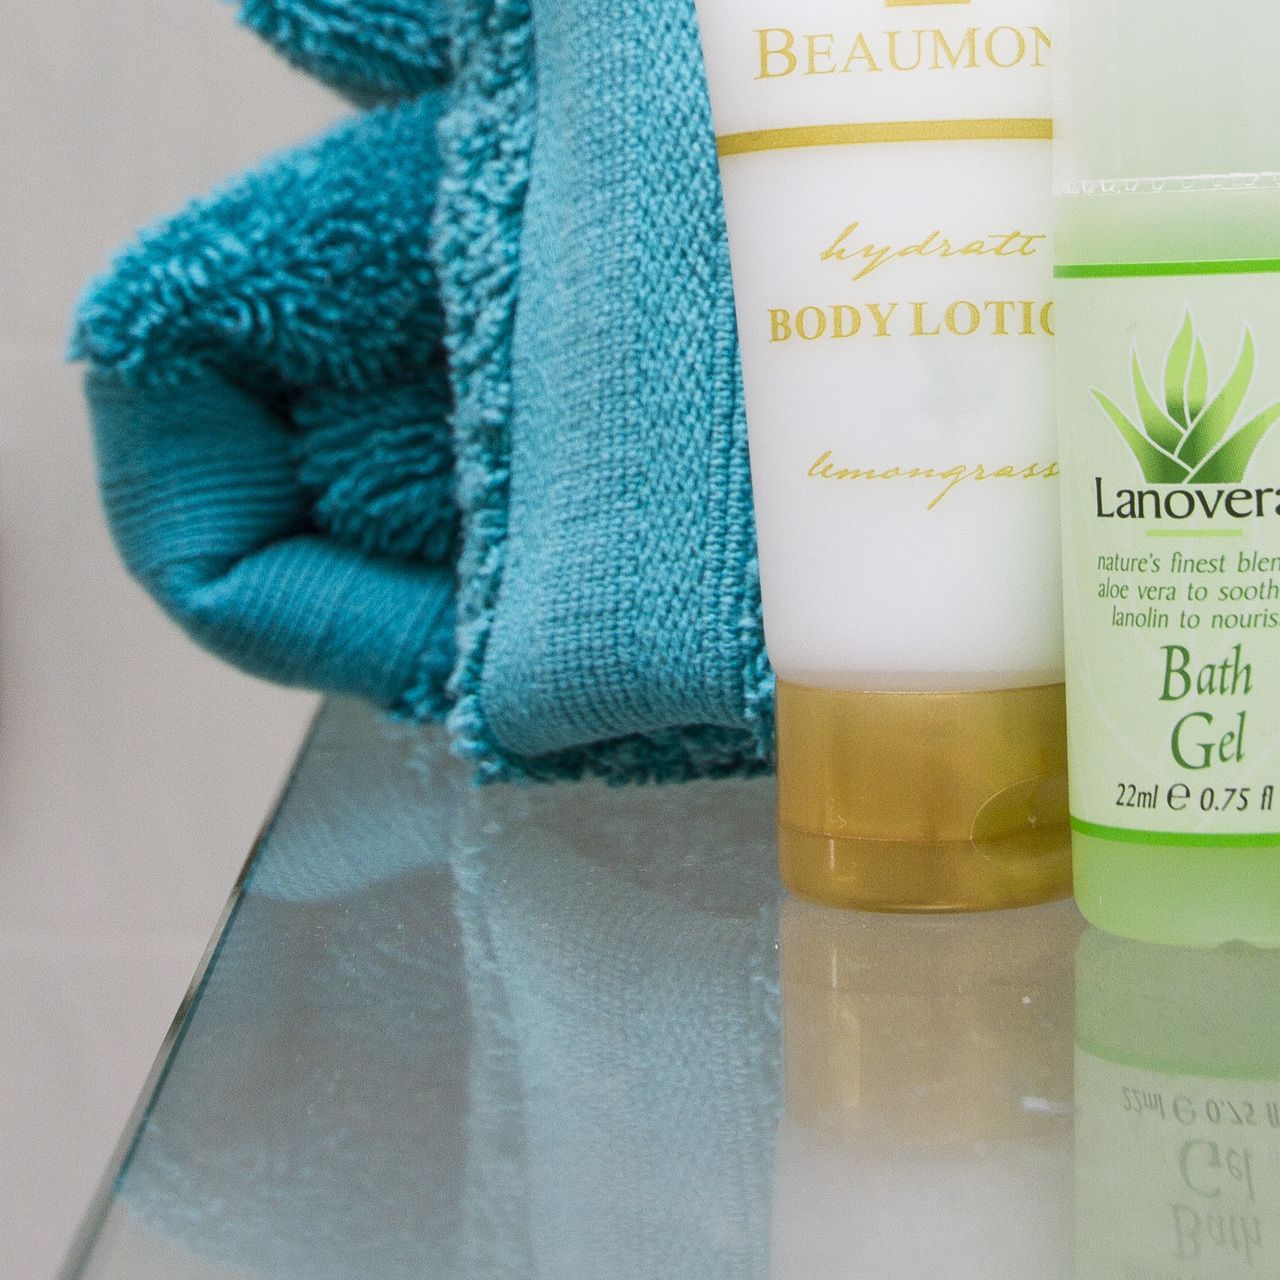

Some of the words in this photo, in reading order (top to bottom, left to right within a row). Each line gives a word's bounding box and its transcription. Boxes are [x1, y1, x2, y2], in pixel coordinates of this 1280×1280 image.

[767, 302, 898, 343] BODY
[807, 449, 1060, 511] lemongrass
[1097, 553, 1161, 574] nature's
[1170, 551, 1226, 574] finest
[1097, 577, 1129, 600] aloe
[1137, 582, 1176, 601] vera
[1187, 582, 1208, 601] to
[1112, 605, 1169, 629] lanolin
[1179, 609, 1200, 629] to
[1158, 642, 1253, 702] Bath
[1170, 710, 1247, 771] Gel
[1115, 783, 1159, 809] 22ml
[1199, 787, 1251, 812] 0.75
[1260, 784, 1275, 811] fl
